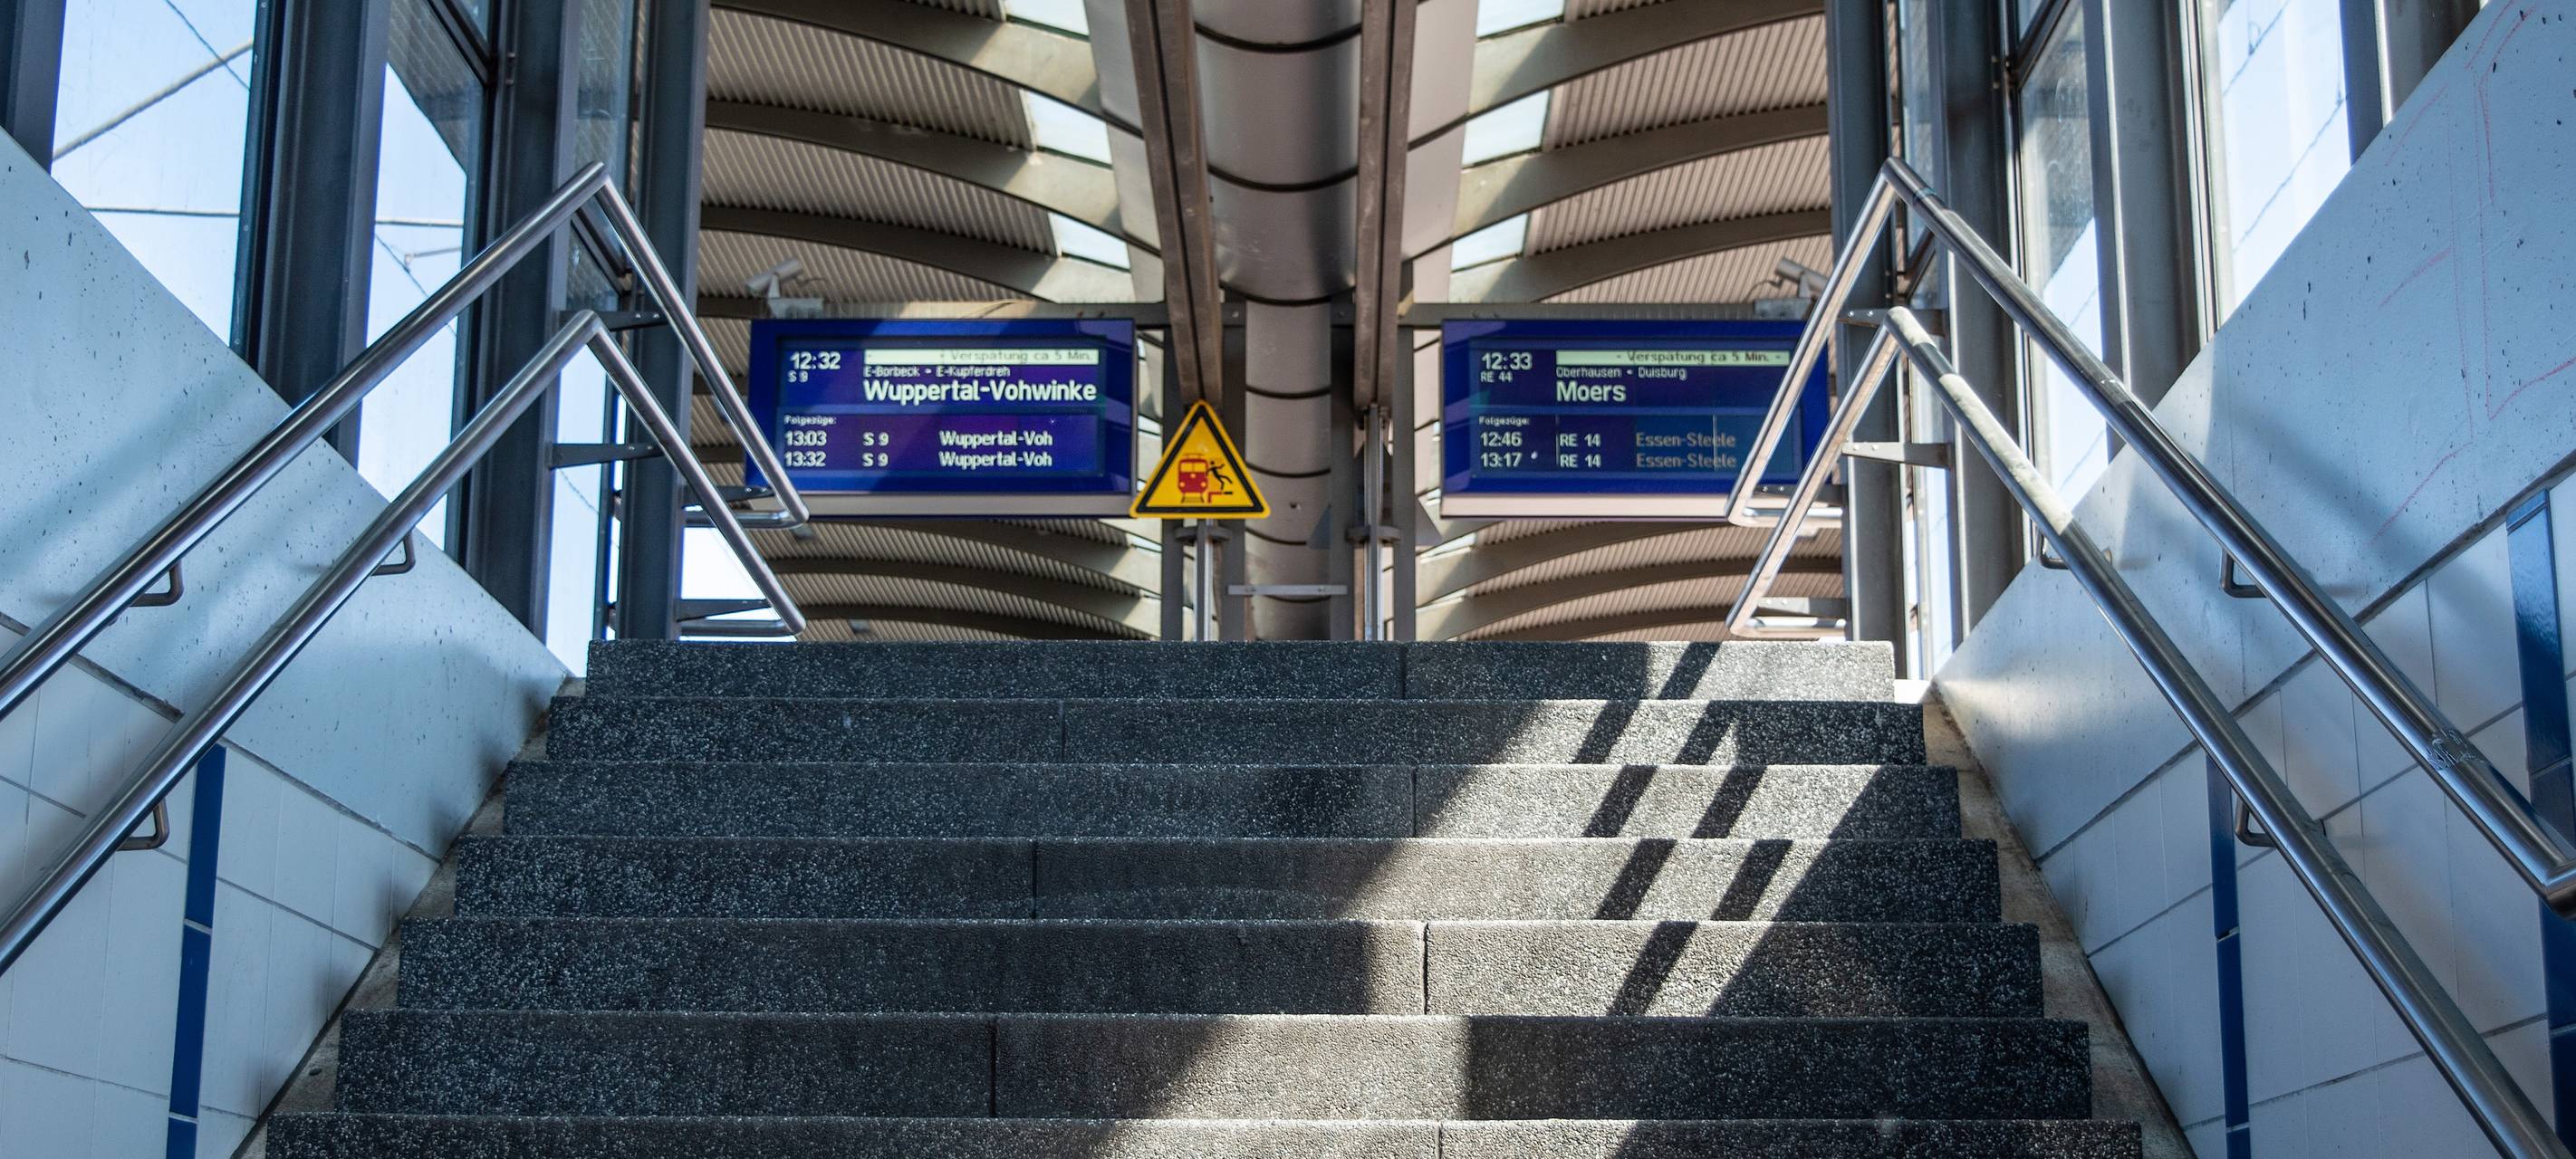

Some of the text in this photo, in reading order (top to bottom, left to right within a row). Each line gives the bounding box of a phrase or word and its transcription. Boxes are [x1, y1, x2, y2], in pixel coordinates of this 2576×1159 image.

[790, 351, 841, 370] 12:32
[1033, 352, 1050, 360] ca
[1054, 350, 1062, 360] 5
[1481, 352, 1533, 370] 12:33
[1710, 353, 1727, 362] ca
[1732, 352, 1740, 362] 5
[1745, 351, 1770, 362] Min.
[788, 371, 809, 382] S 9
[863, 366, 1011, 378] E-Borbeck E-Kupferdreh
[1480, 372, 1513, 382] RE 44
[1556, 366, 1687, 381] Oberhausen Duisburg
[1556, 380, 1627, 402] Moers
[784, 431, 828, 446] 13:03
[862, 431, 889, 446] S 9
[939, 430, 1053, 450] Wuppertal-Voh
[1480, 432, 1523, 447] 12:46
[1559, 433, 1601, 447] RE 14
[1636, 432, 1736, 447] Essen-Steele
[784, 452, 827, 467] 13:32
[861, 452, 889, 467] S 9
[939, 451, 1053, 471] Wuppertal-Voh
[1480, 453, 1523, 468] 13:17
[1559, 454, 1602, 468] RE 14
[1636, 453, 1737, 468] Essen-Steele
